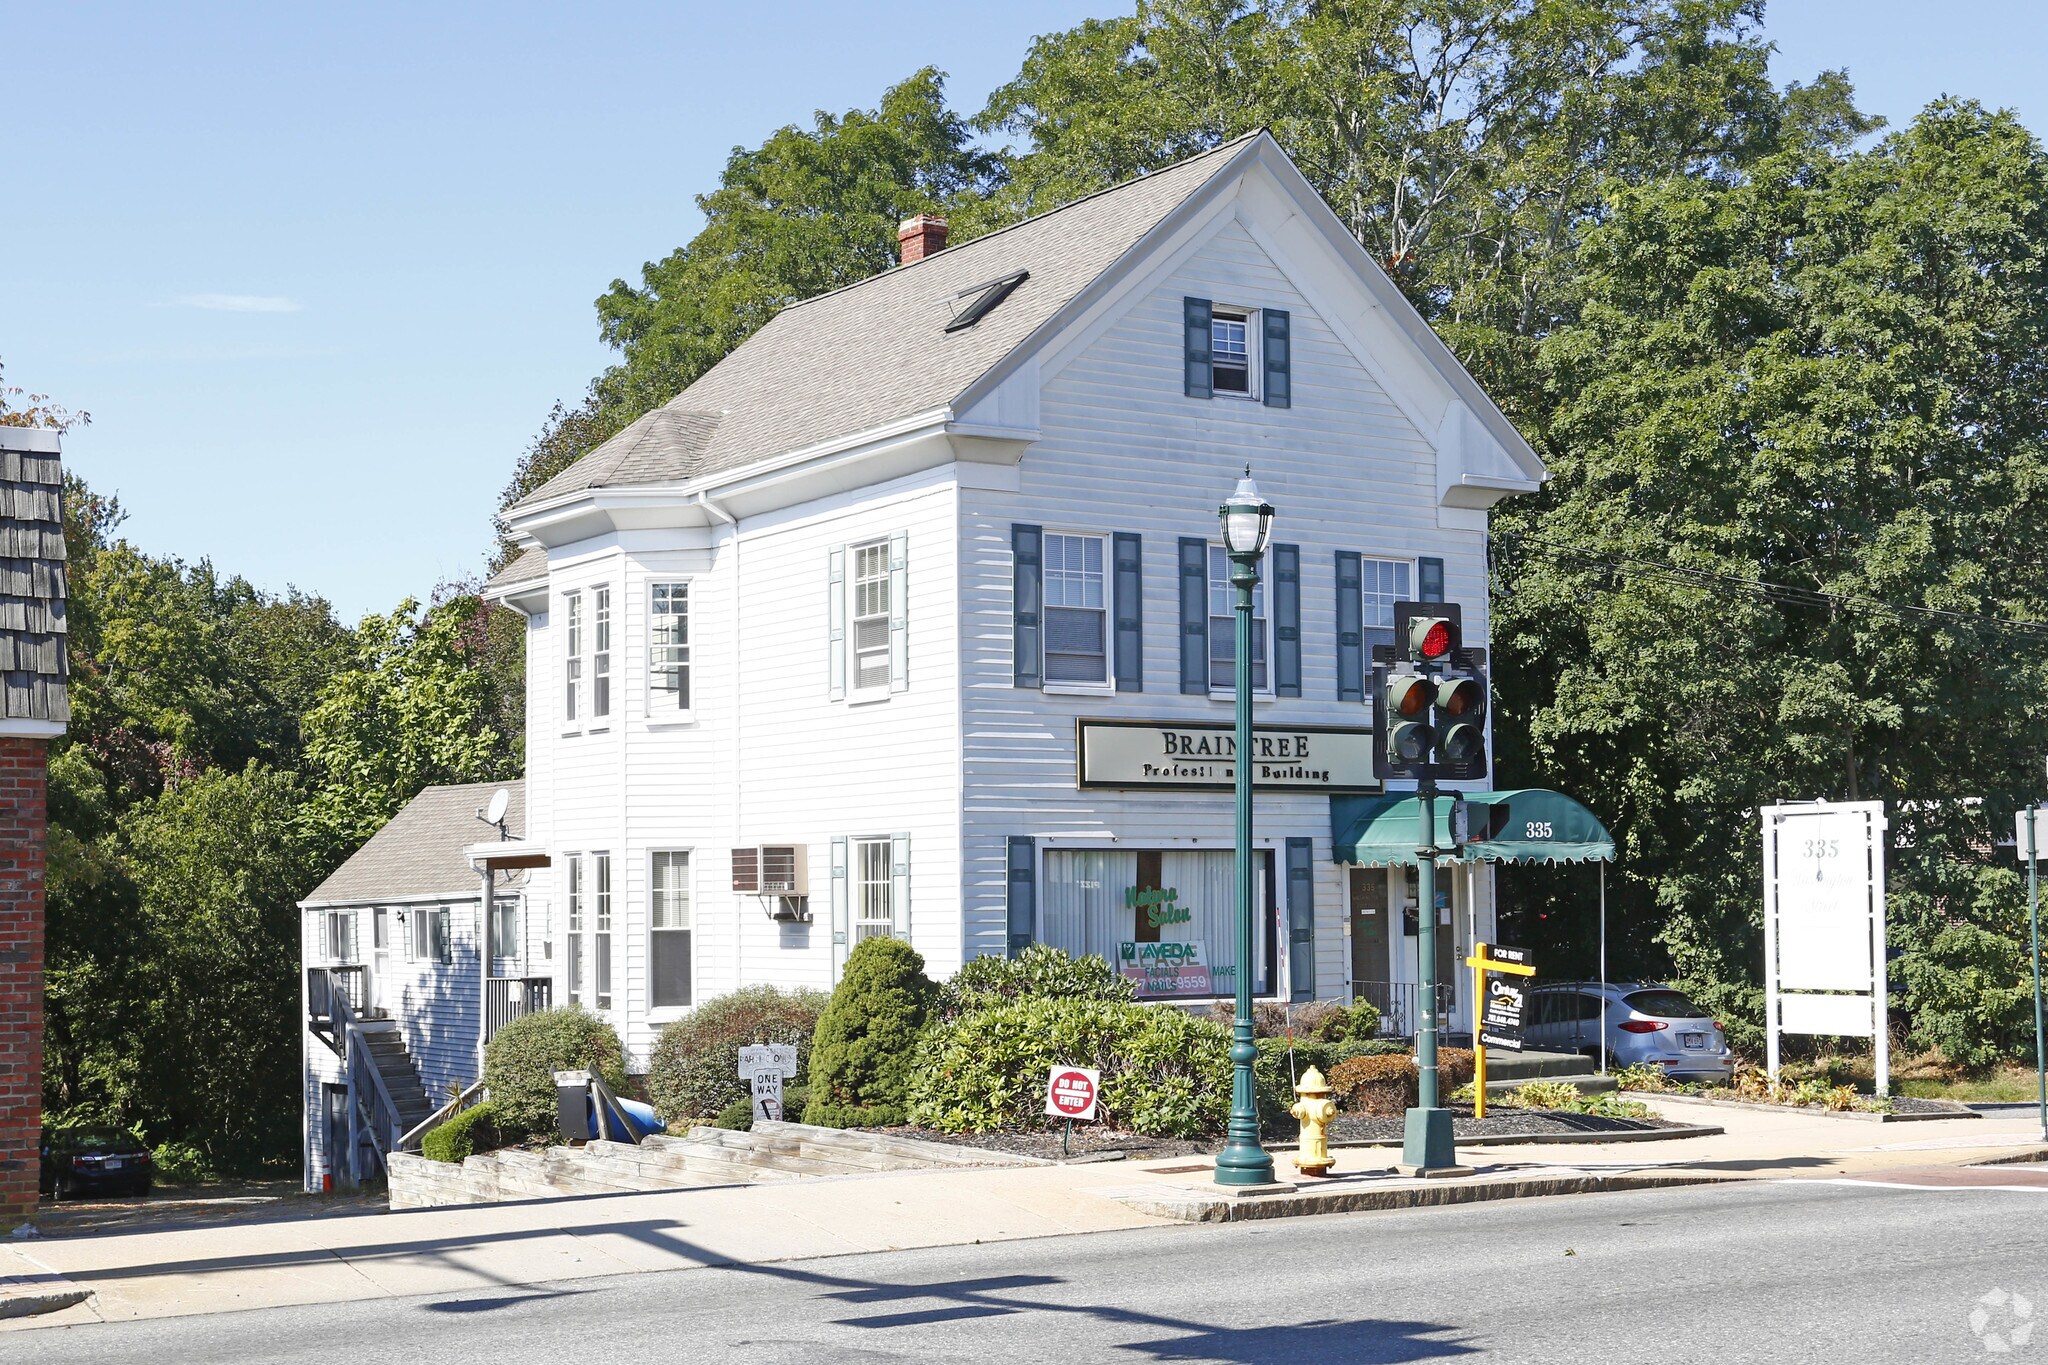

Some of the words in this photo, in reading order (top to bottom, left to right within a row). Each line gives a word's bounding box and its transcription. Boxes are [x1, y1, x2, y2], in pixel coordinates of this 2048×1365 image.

[1162, 732, 1309, 757] BRAINTREE
[1142, 763, 1236, 777] Professin
[1262, 766, 1329, 782] Building
[1526, 822, 1552, 838] 335
[1802, 838, 1840, 859] 335
[1147, 903, 1191, 928] Salon
[1142, 943, 1195, 958] AVEDA
[1493, 948, 1507, 959] FOR
[1508, 950, 1524, 961] RENT
[1145, 967, 1179, 977] FACIALS
[1213, 966, 1236, 976] MAKE
[1148, 981, 1177, 992] NAILS
[1481, 1033, 1522, 1049] Commercial
[757, 1074, 778, 1084] ONE
[1058, 1078, 1070, 1089] DO
[1072, 1079, 1088, 1091] NOT
[757, 1085, 778, 1095] WAY
[1059, 1095, 1084, 1107] ENTER
